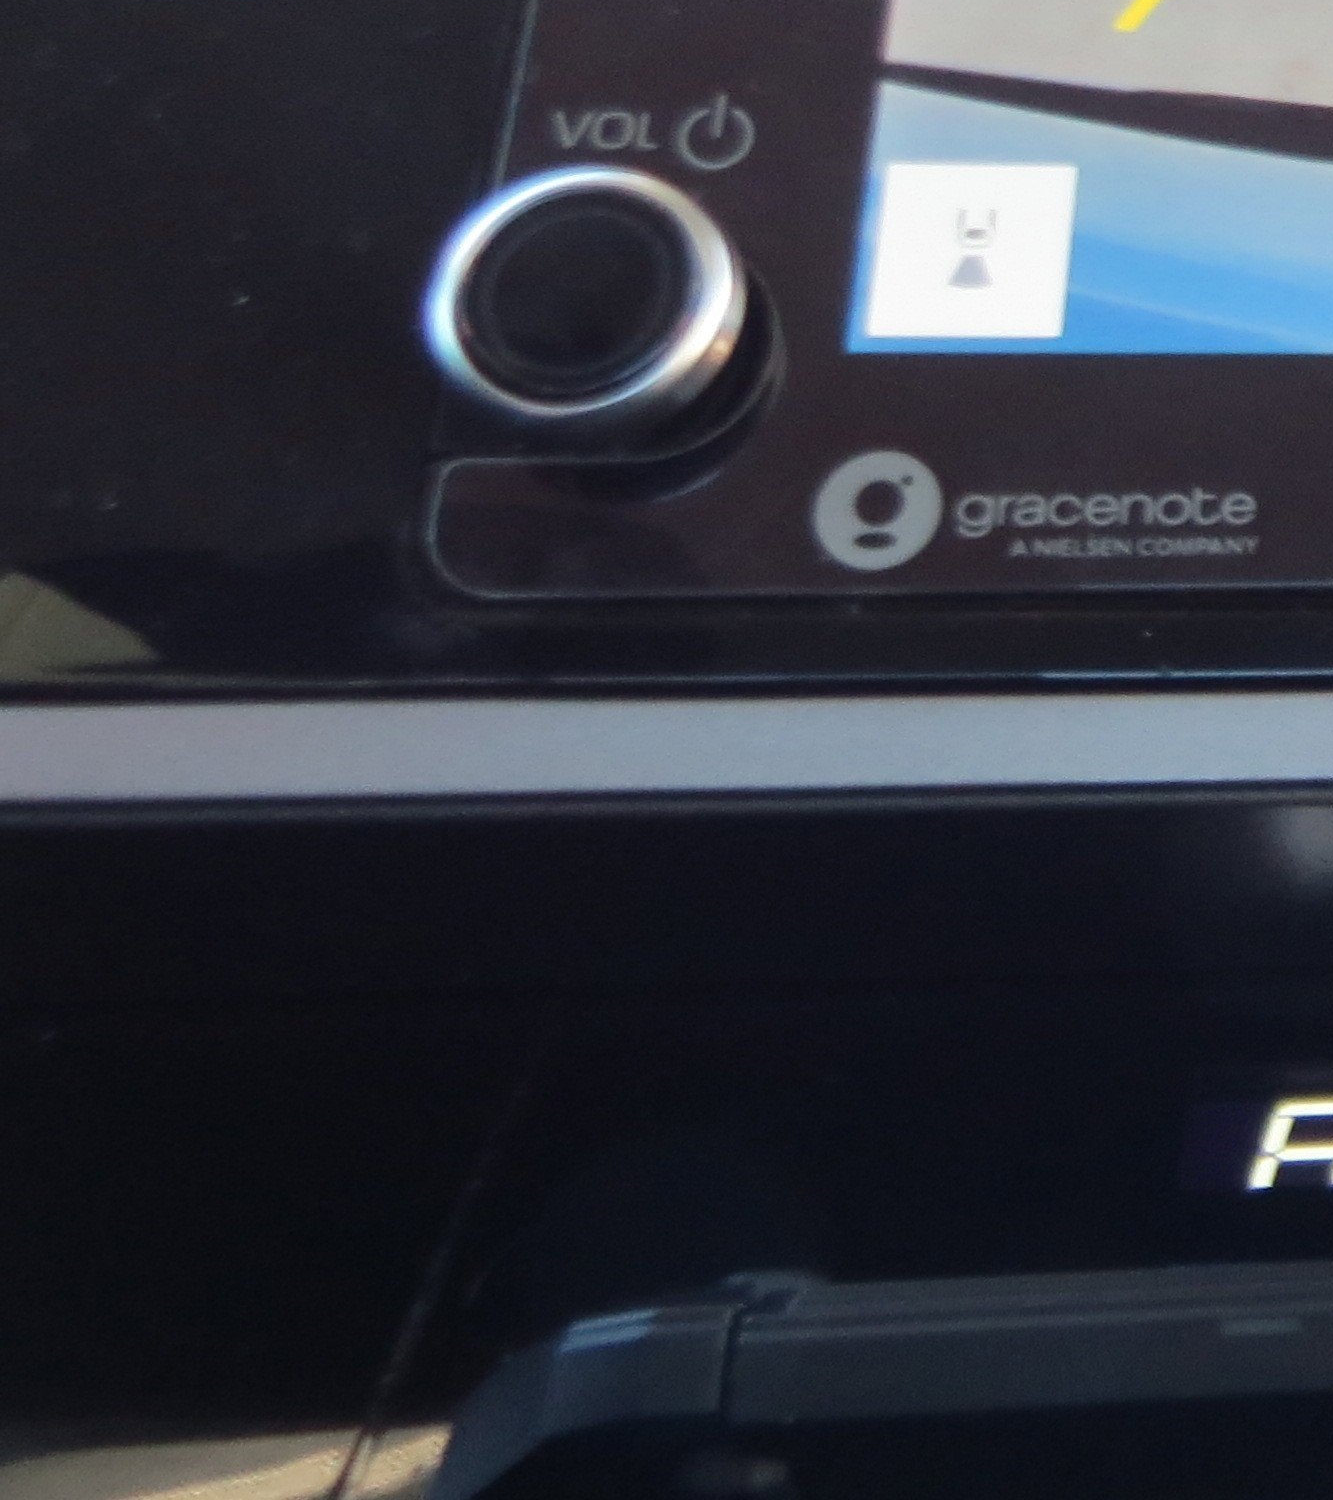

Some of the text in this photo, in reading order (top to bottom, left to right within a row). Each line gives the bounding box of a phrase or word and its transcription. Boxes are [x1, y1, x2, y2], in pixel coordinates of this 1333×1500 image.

[553, 109, 658, 149] VOL
[956, 487, 1257, 539] gracenote
[1008, 536, 1260, 557] A NIELSEN COMPANY
